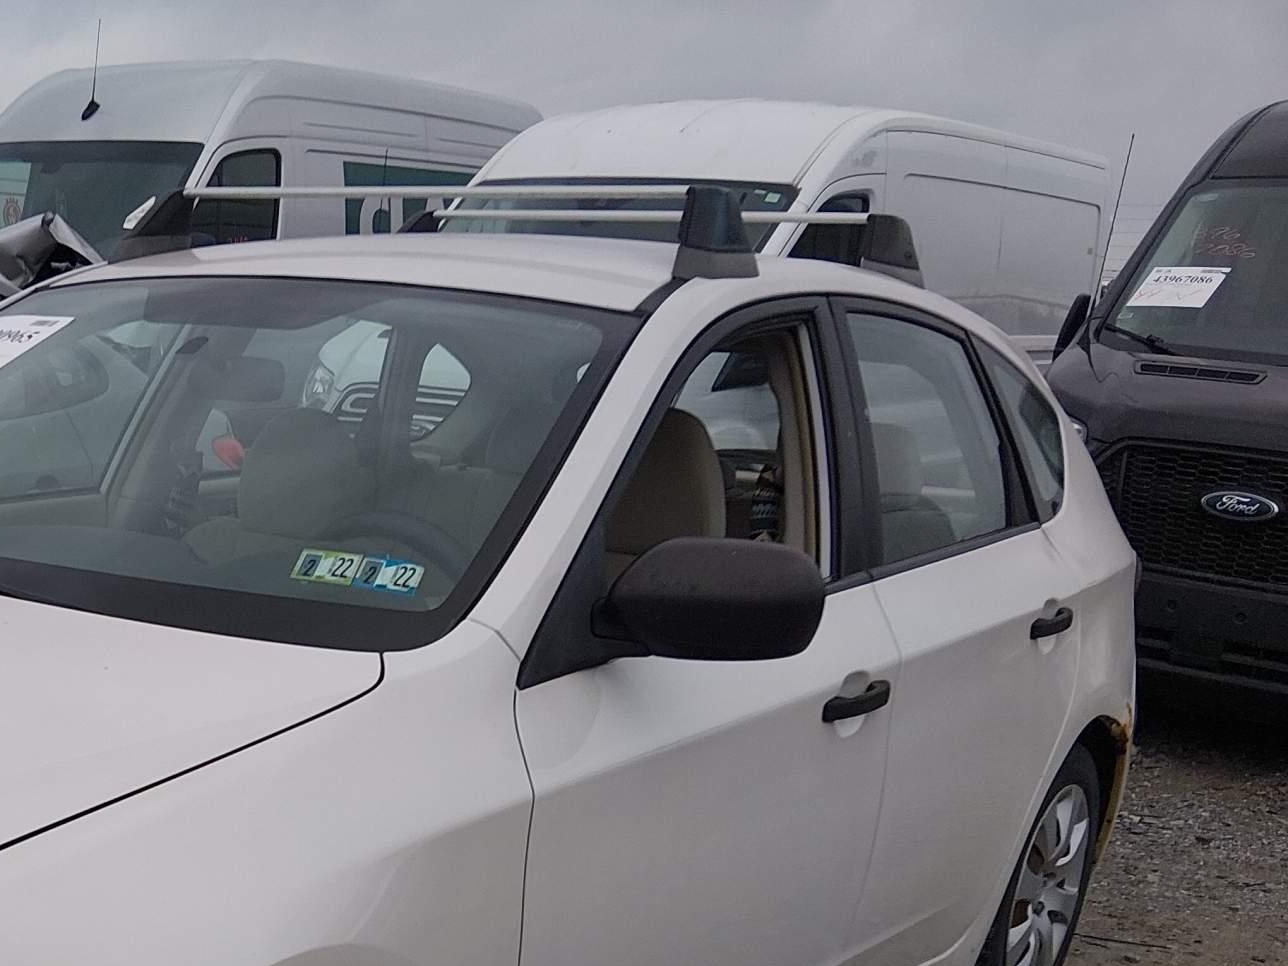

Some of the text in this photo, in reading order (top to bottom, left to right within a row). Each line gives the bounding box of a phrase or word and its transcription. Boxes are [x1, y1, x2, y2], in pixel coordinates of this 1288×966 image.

[1153, 275, 1213, 284] 43967086
[1215, 494, 1260, 515] Ford
[331, 557, 354, 578] 22
[393, 566, 416, 588] 22
